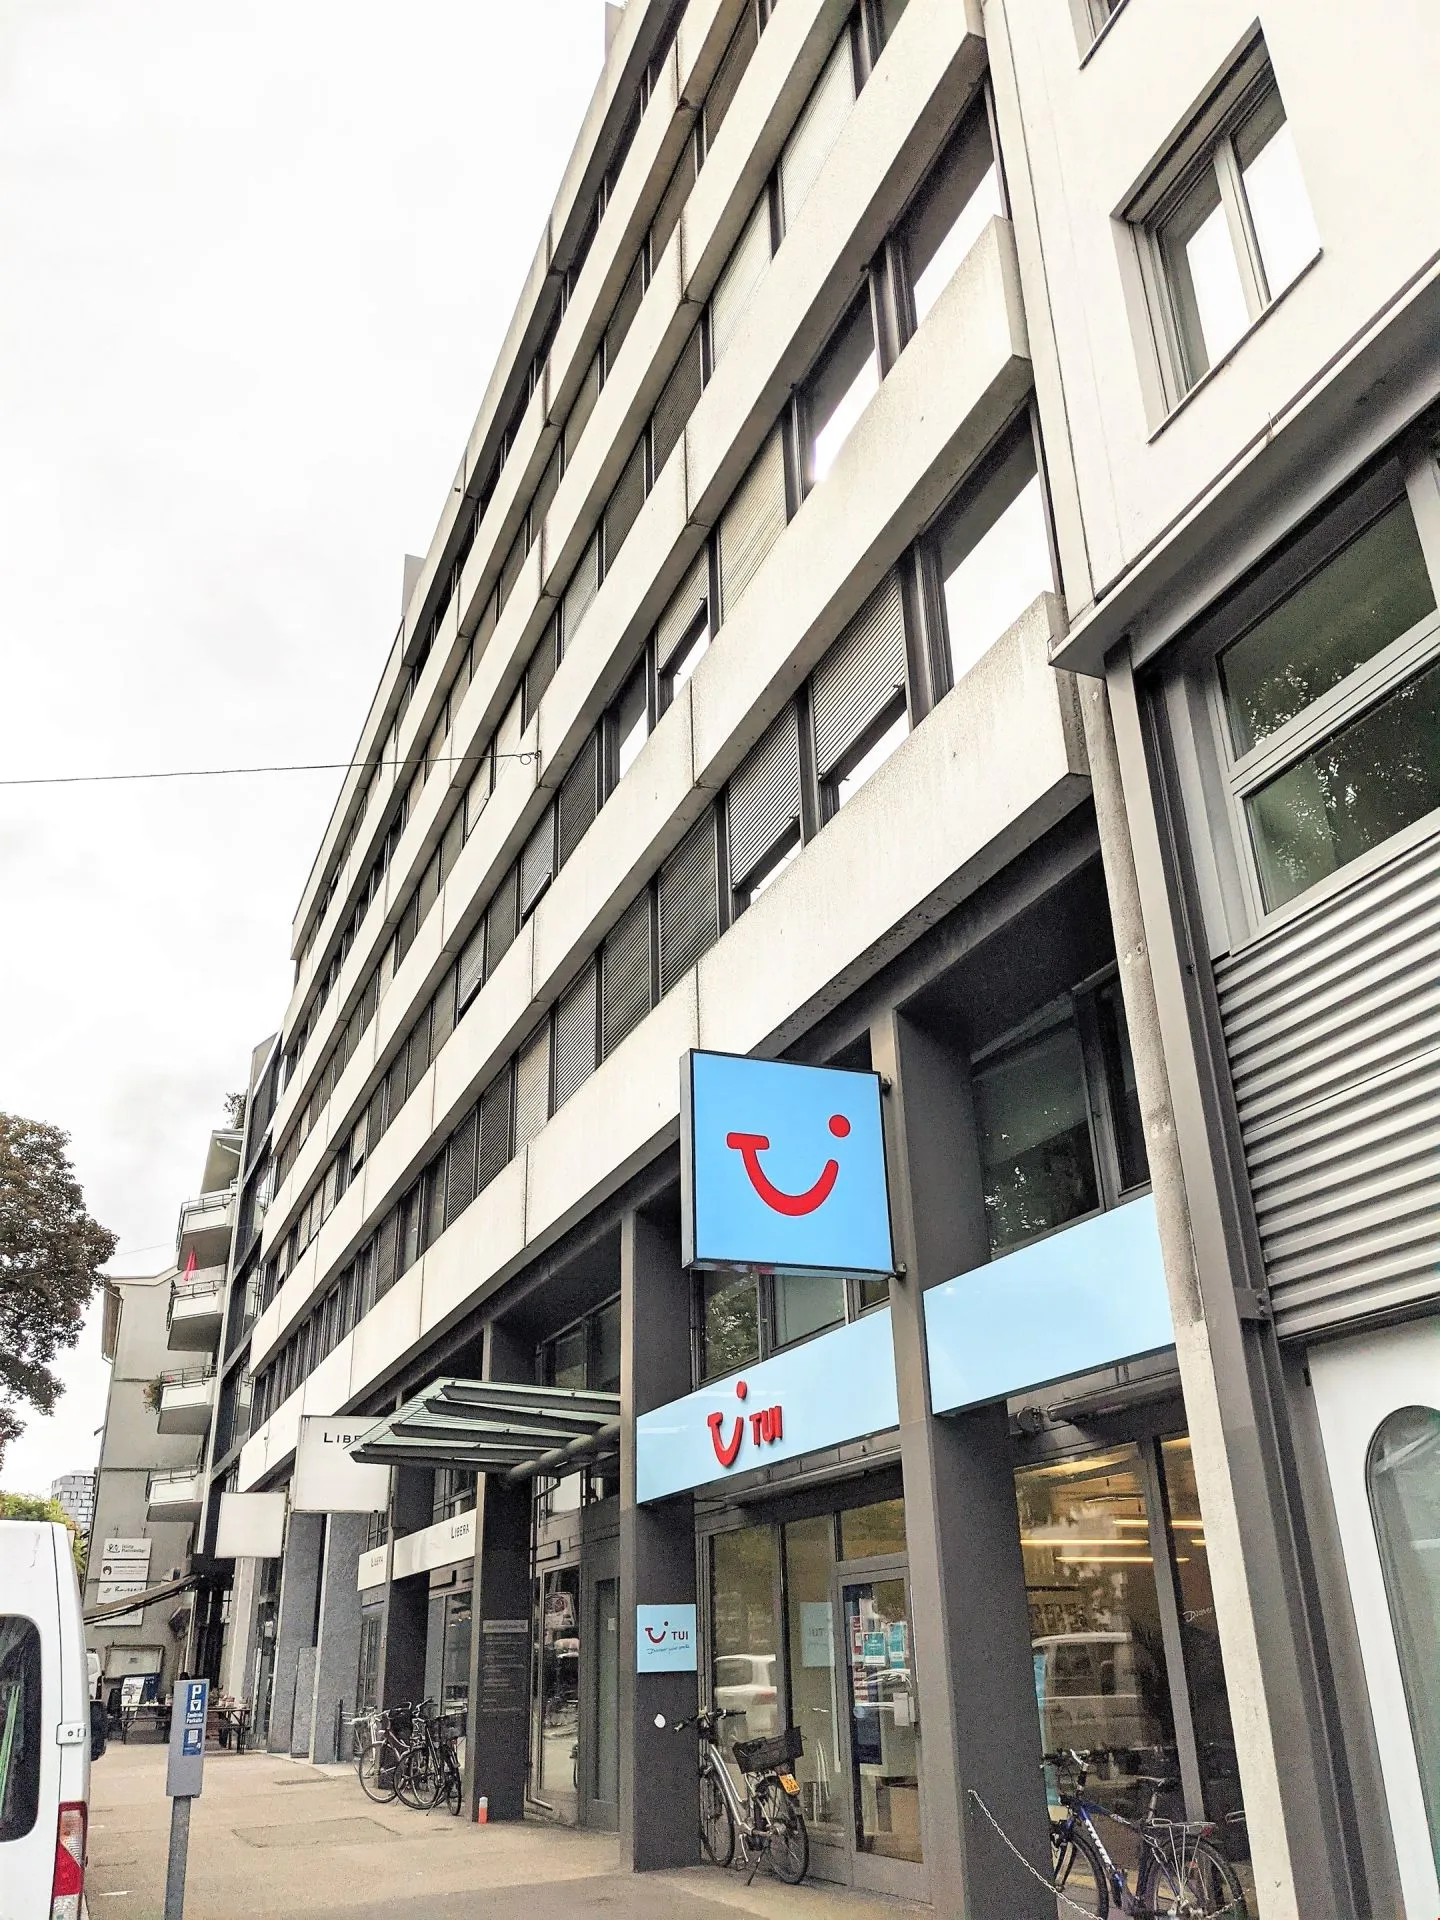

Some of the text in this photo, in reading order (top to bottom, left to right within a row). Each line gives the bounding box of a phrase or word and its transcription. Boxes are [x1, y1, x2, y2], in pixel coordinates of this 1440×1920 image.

[749, 1405, 783, 1447] TUI
[450, 1523, 470, 1539] LIBERA
[671, 1631, 689, 1641] TUI
